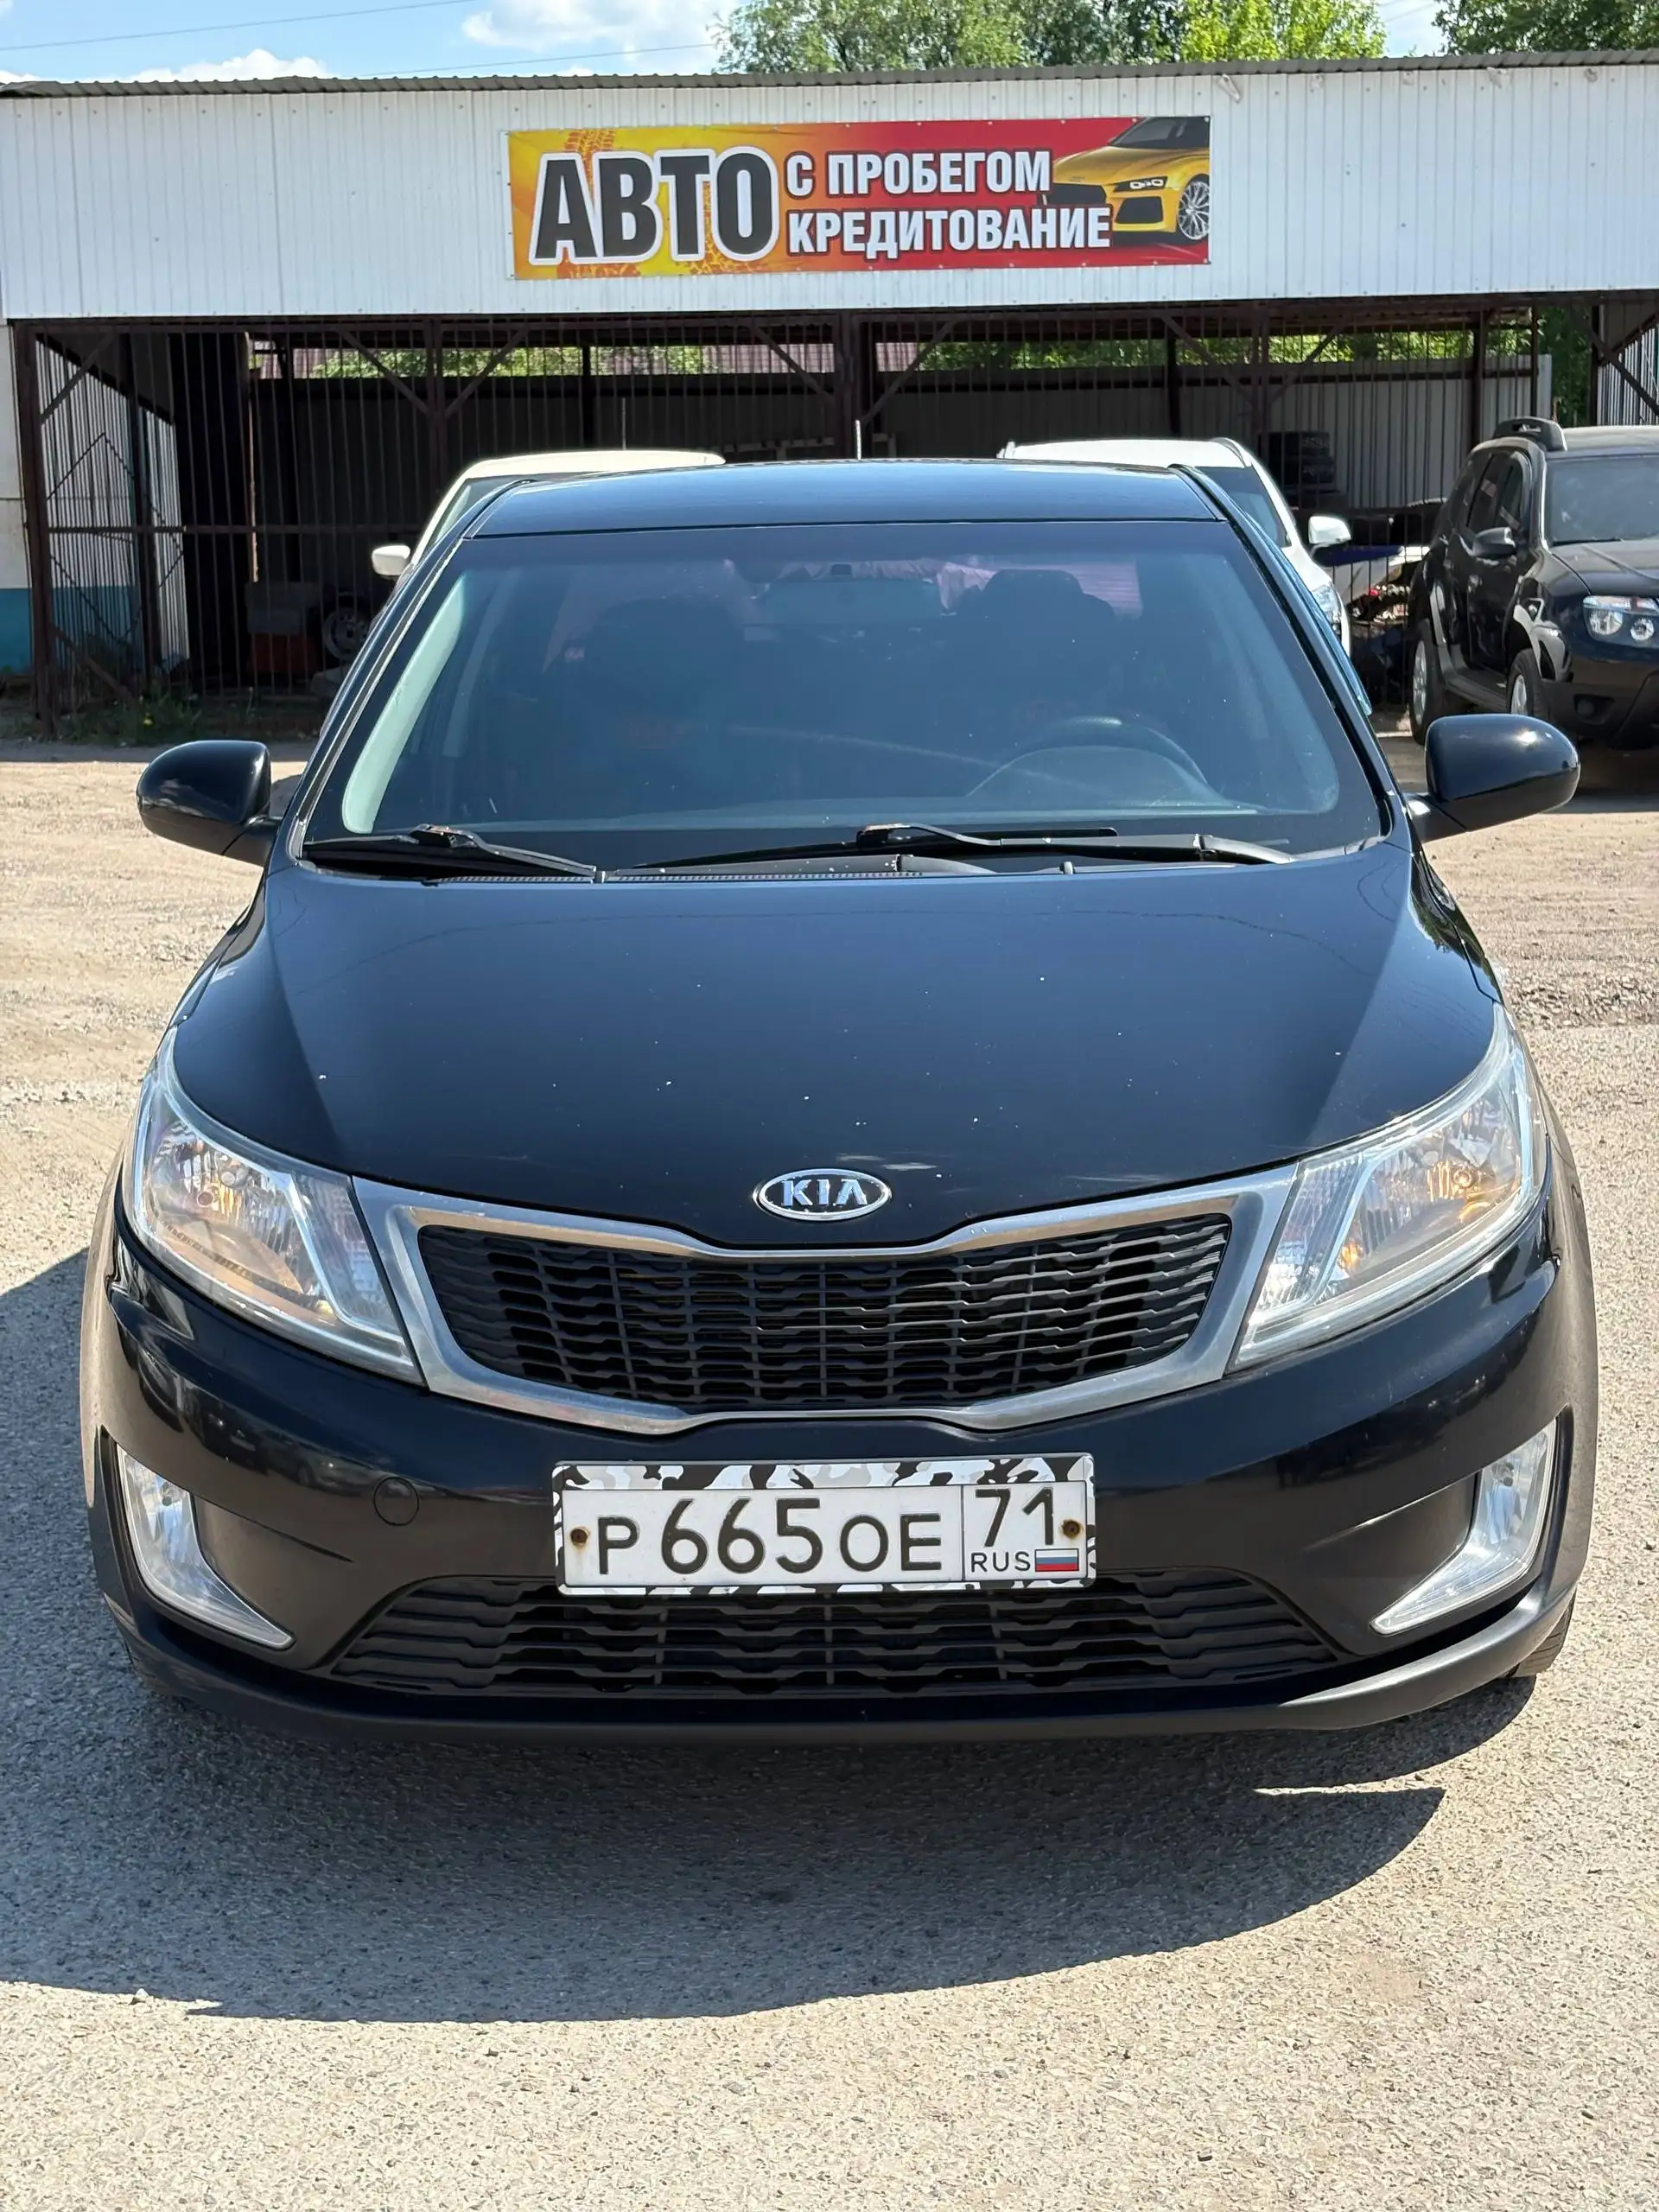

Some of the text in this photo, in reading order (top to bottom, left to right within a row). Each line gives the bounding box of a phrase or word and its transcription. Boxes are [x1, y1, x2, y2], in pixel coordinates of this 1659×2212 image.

[787, 149, 1052, 197] С ПРОБЕГОМ
[531, 149, 778, 264] АВТО
[788, 205, 1111, 259] КРЕДИТОВАНИЕ
[781, 1179, 868, 1207] KIA
[975, 1485, 1055, 1548] 71
[970, 1551, 1031, 1573] RUS
